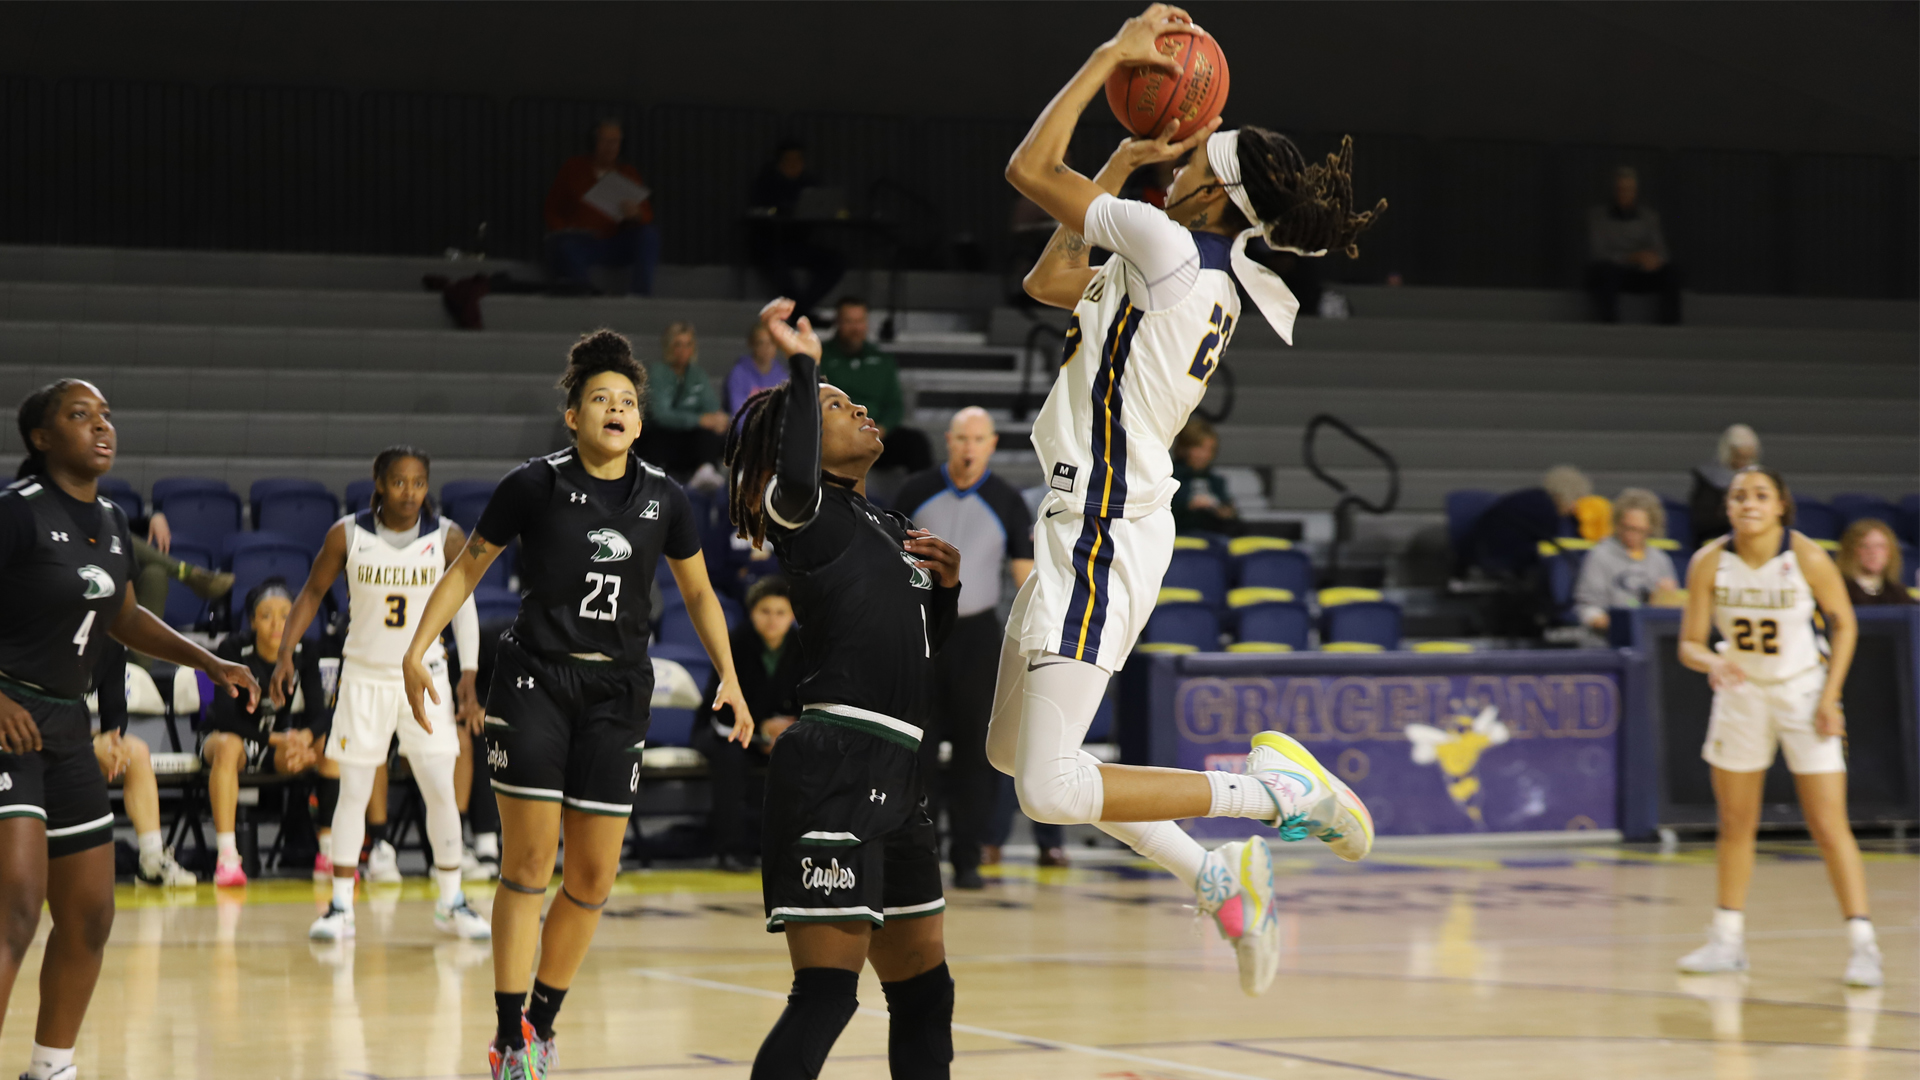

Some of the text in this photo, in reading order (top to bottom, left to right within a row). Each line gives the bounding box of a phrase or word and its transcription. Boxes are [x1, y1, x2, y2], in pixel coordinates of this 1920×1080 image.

[1136, 36, 1184, 117] SPALNG
[1059, 465, 1070, 476] M
[357, 564, 437, 586] GRACELAND
[578, 571, 622, 622] 23
[384, 593, 408, 629] 3
[919, 603, 931, 659] 1
[72, 610, 97, 656] 4
[1732, 617, 1779, 655] 22
[1175, 676, 1620, 743] GRACELAND
[800, 856, 856, 896] Eagles
